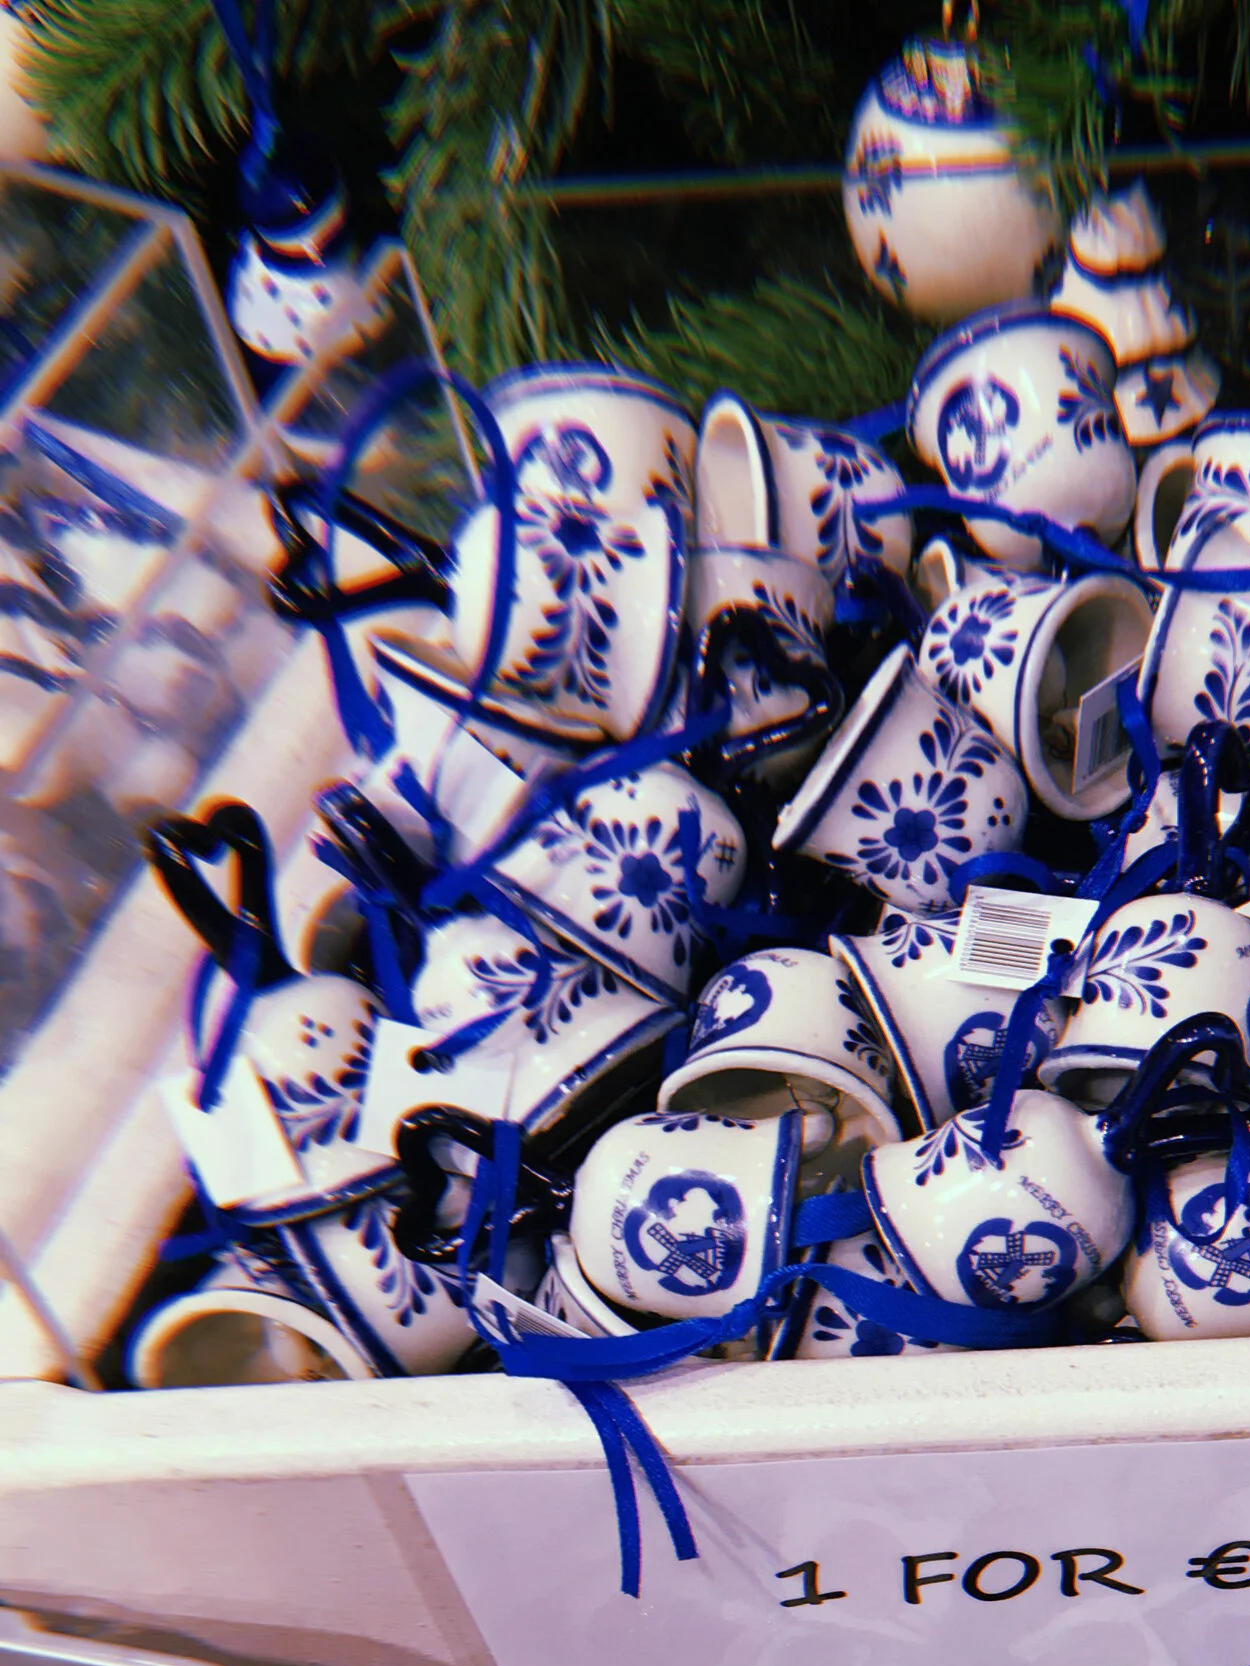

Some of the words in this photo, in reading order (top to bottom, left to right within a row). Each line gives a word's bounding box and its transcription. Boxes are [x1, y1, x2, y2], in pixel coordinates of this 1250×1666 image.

[610, 1150, 651, 1242] CHRITMAS
[1016, 1175, 1074, 1220] MERRY
[610, 1243, 640, 1301] MERRY
[1162, 1275, 1199, 1329] MERRY
[774, 1559, 847, 1608] 1
[900, 1547, 1145, 1605] FOR
